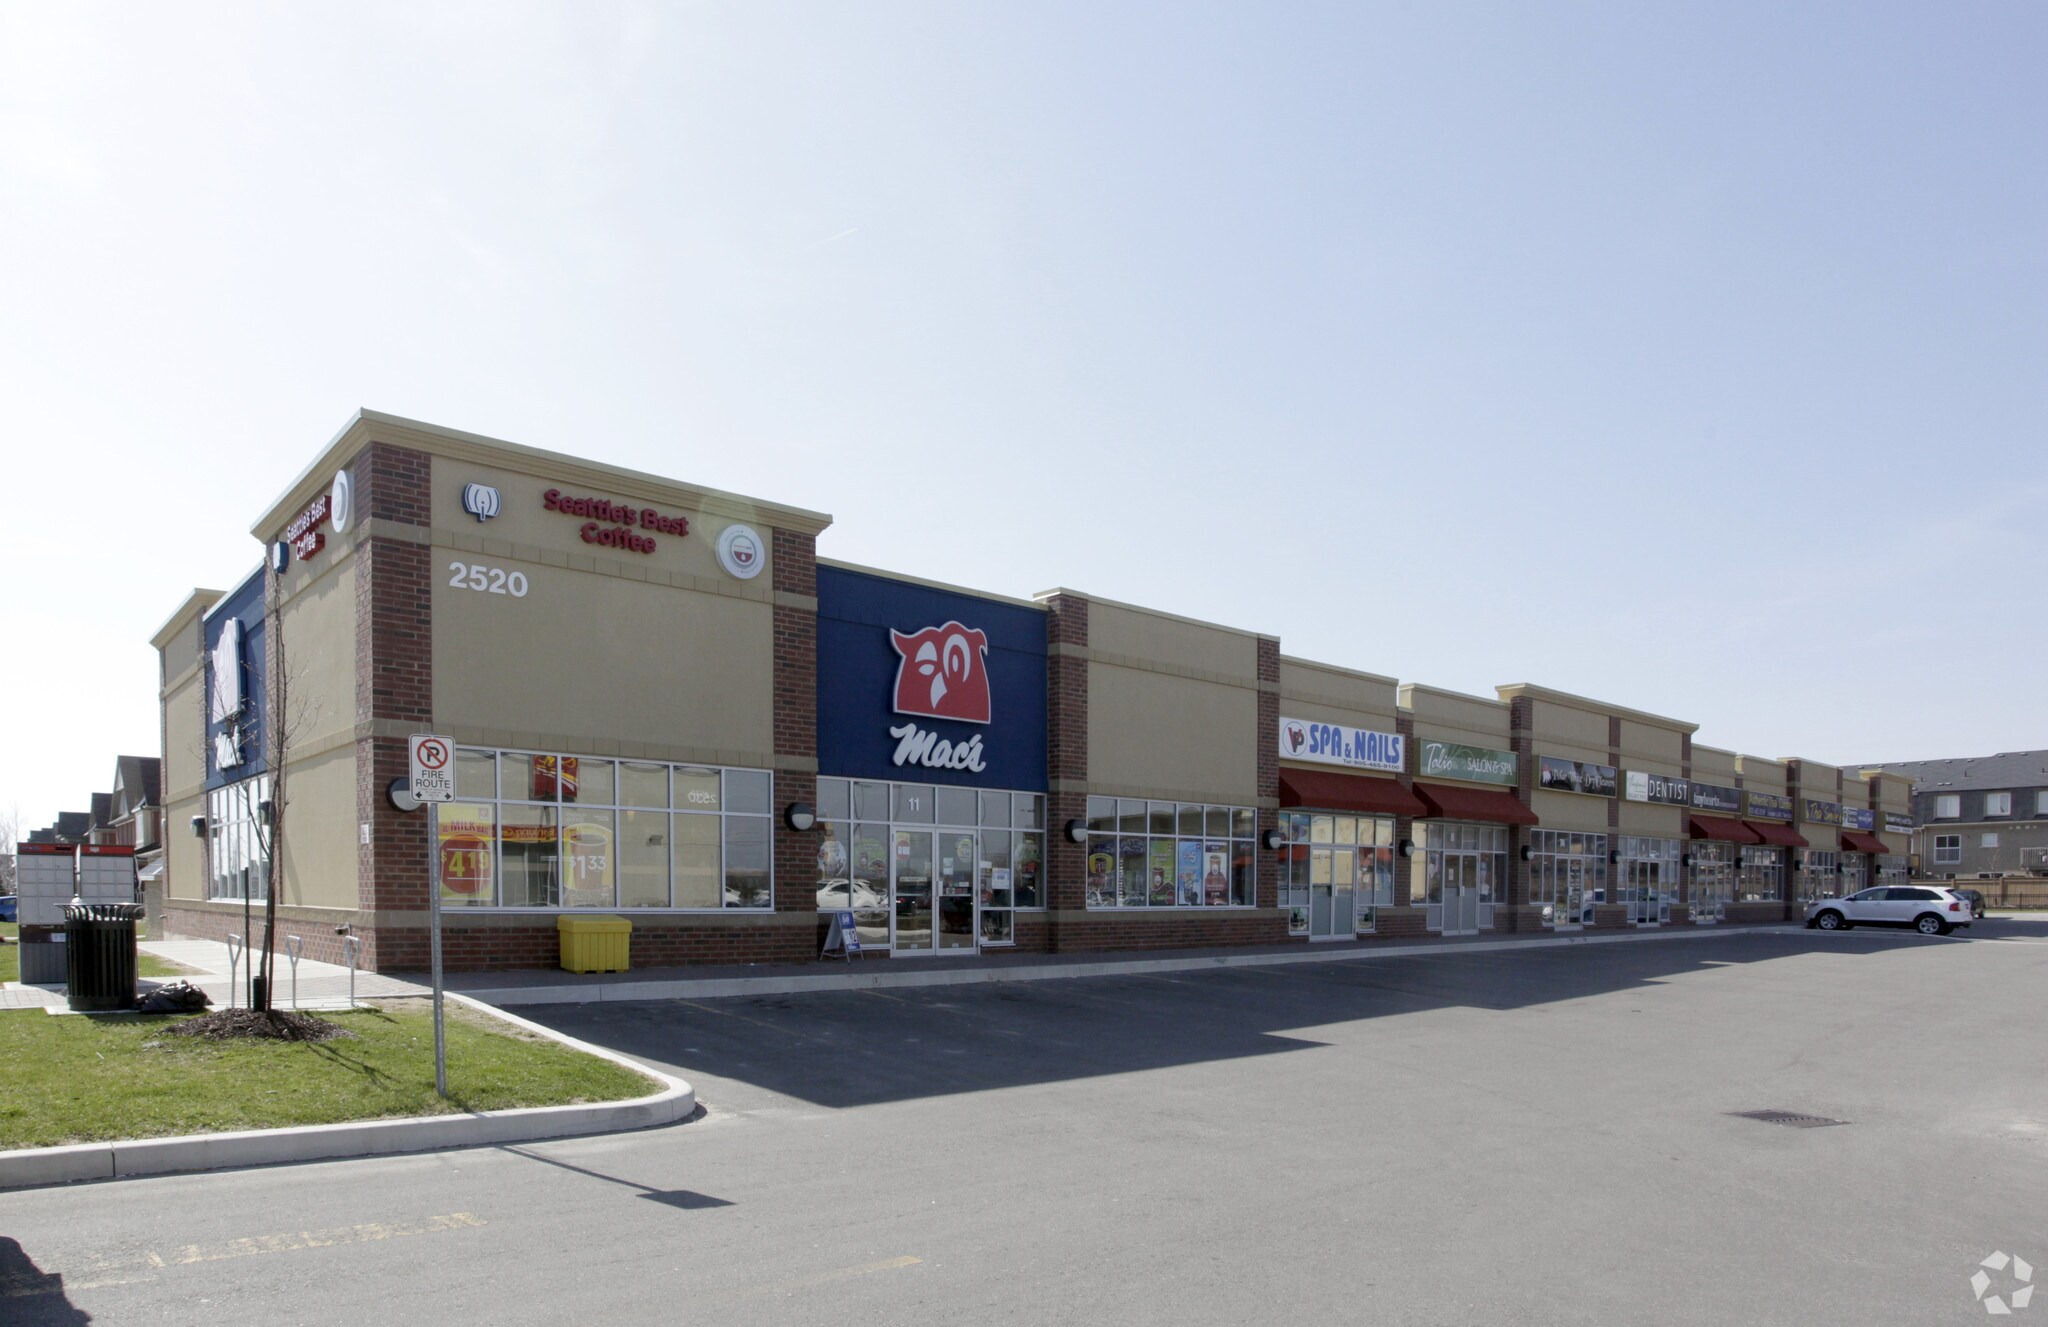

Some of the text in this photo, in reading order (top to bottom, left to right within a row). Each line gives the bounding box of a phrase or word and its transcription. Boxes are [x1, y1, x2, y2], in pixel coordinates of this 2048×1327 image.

[544, 489, 689, 537] Seattle's Best
[580, 522, 657, 553] Coffee
[449, 562, 528, 597] 2520
[889, 723, 987, 772] Mac's
[1309, 724, 1400, 764] SPA & NAILS
[1426, 743, 1453, 774] Talio
[1467, 757, 1492, 773] SALON
[1500, 762, 1513, 776] SPA
[415, 779, 450, 788] ROUTE
[422, 770, 444, 780] FIRE
[1649, 780, 1688, 800] DENTIST
[908, 797, 919, 811] 11
[450, 820, 476, 831] MILK
[1450, 832, 1455, 842] 8
